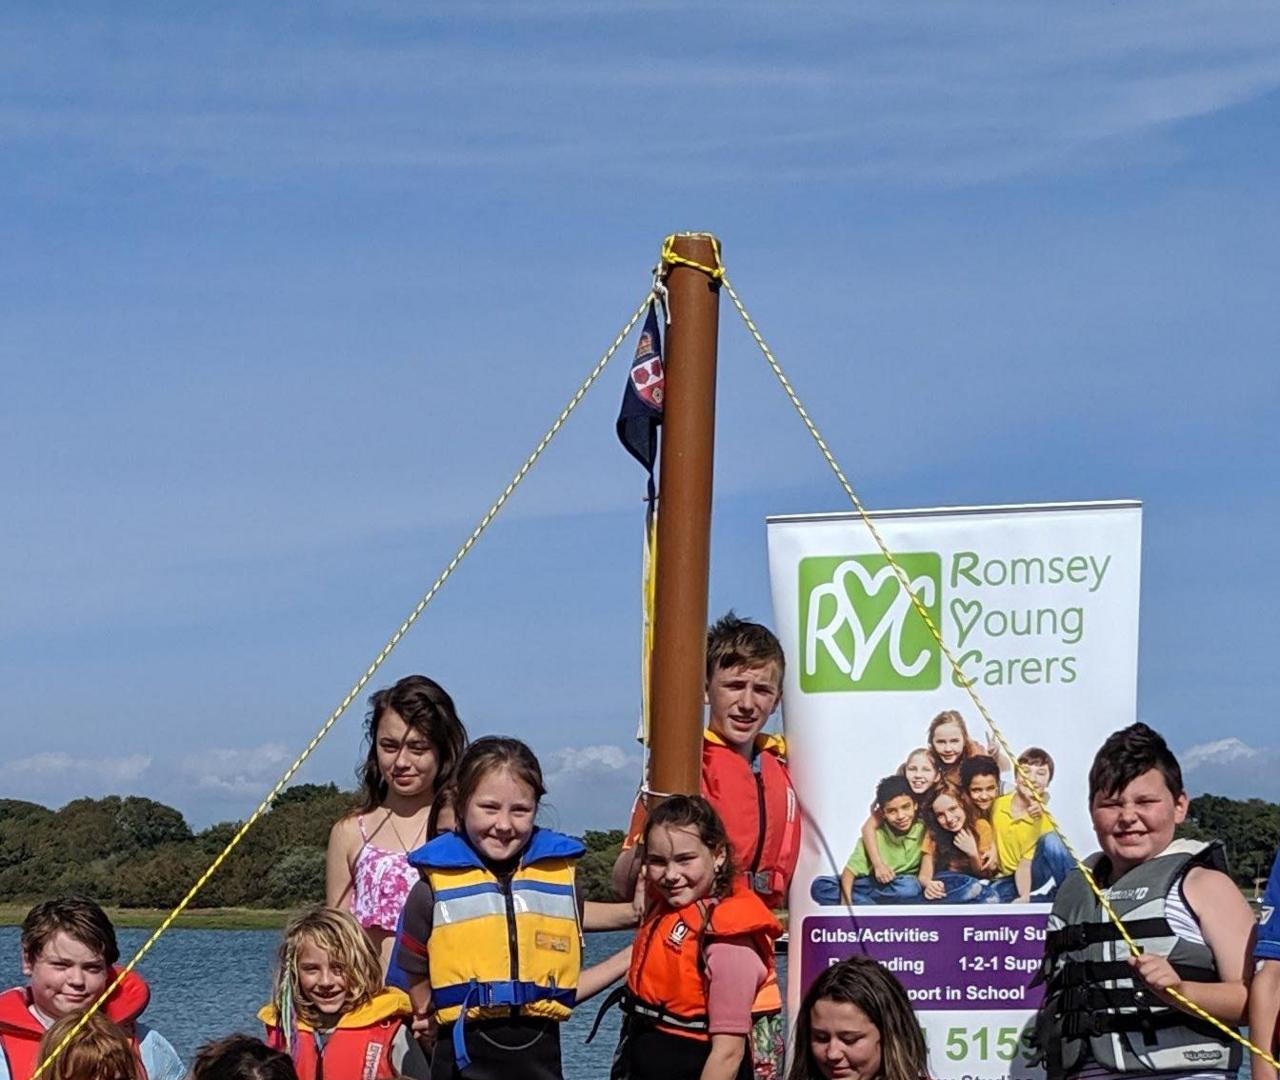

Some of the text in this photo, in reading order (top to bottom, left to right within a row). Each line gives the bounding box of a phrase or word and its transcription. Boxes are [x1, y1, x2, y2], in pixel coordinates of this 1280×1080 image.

[950, 552, 1112, 593] Romsey
[951, 650, 1077, 689] Carers
[810, 928, 940, 943] Clubs/Activities
[963, 927, 1019, 945] Family
[958, 956, 998, 971] 1-2-1
[946, 985, 961, 1000] in
[966, 985, 1025, 1000] School
